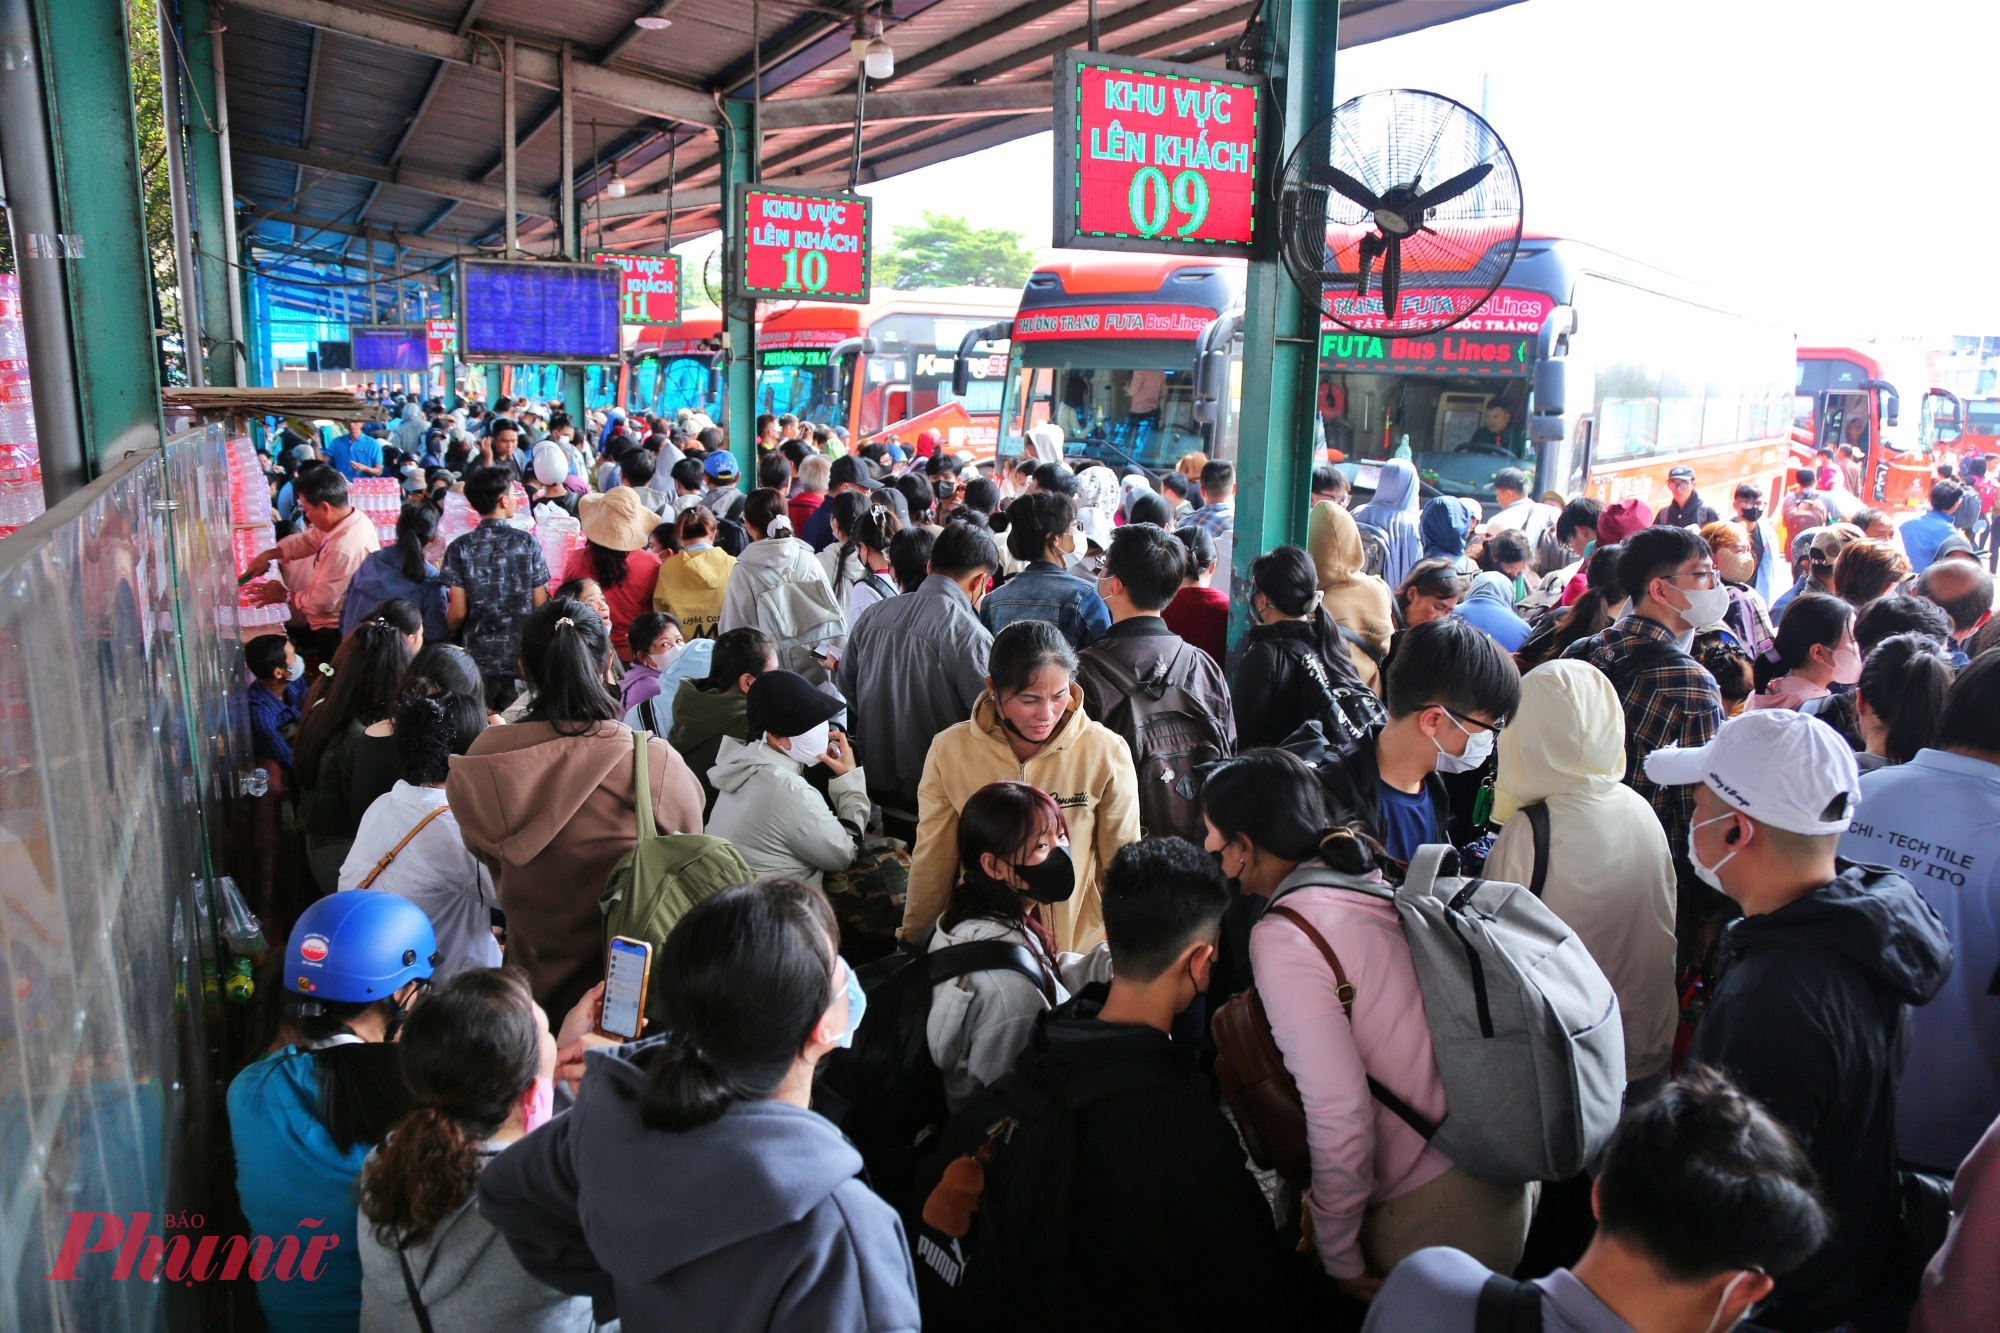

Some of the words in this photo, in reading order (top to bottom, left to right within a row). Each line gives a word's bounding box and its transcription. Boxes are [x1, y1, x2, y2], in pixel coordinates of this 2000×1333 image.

[1105, 79, 1165, 116] KHU
[1173, 86, 1231, 128] VỰC
[1091, 119, 1146, 163] LÊN
[1154, 129, 1248, 173] KHÁCH
[763, 199, 802, 220] KHU
[806, 201, 846, 227] VỰC
[1128, 166, 1209, 236] 09
[753, 222, 790, 247] LÊN
[794, 227, 858, 253] KHÁCH
[781, 248, 828, 291] 10
[627, 276, 673, 294] KHÁCH
[622, 291, 650, 319] 11
[1402, 295, 1454, 315] FUTA
[1490, 296, 1541, 318] Lines
[1060, 314, 1099, 331] TRANG
[1104, 313, 1144, 331] FUTA
[1145, 313, 1170, 331] Bus
[1170, 313, 1208, 332] Lines
[1453, 316, 1481, 330] SÓC
[1485, 318, 1540, 332] TRĂNG
[440, 339, 457, 353] 14
[805, 351, 844, 366] TRA
[1322, 335, 1384, 359] FUTA
[1390, 338, 1436, 360] Bus
[1442, 337, 1511, 362] Lines
[683, 615, 703, 626] Light
[1888, 831, 1931, 855] TECH
[1936, 845, 1974, 870] TILE
[1899, 854, 1922, 871] BY
[1924, 862, 1966, 887] ITO
[917, 1234, 960, 1287] PUMA
